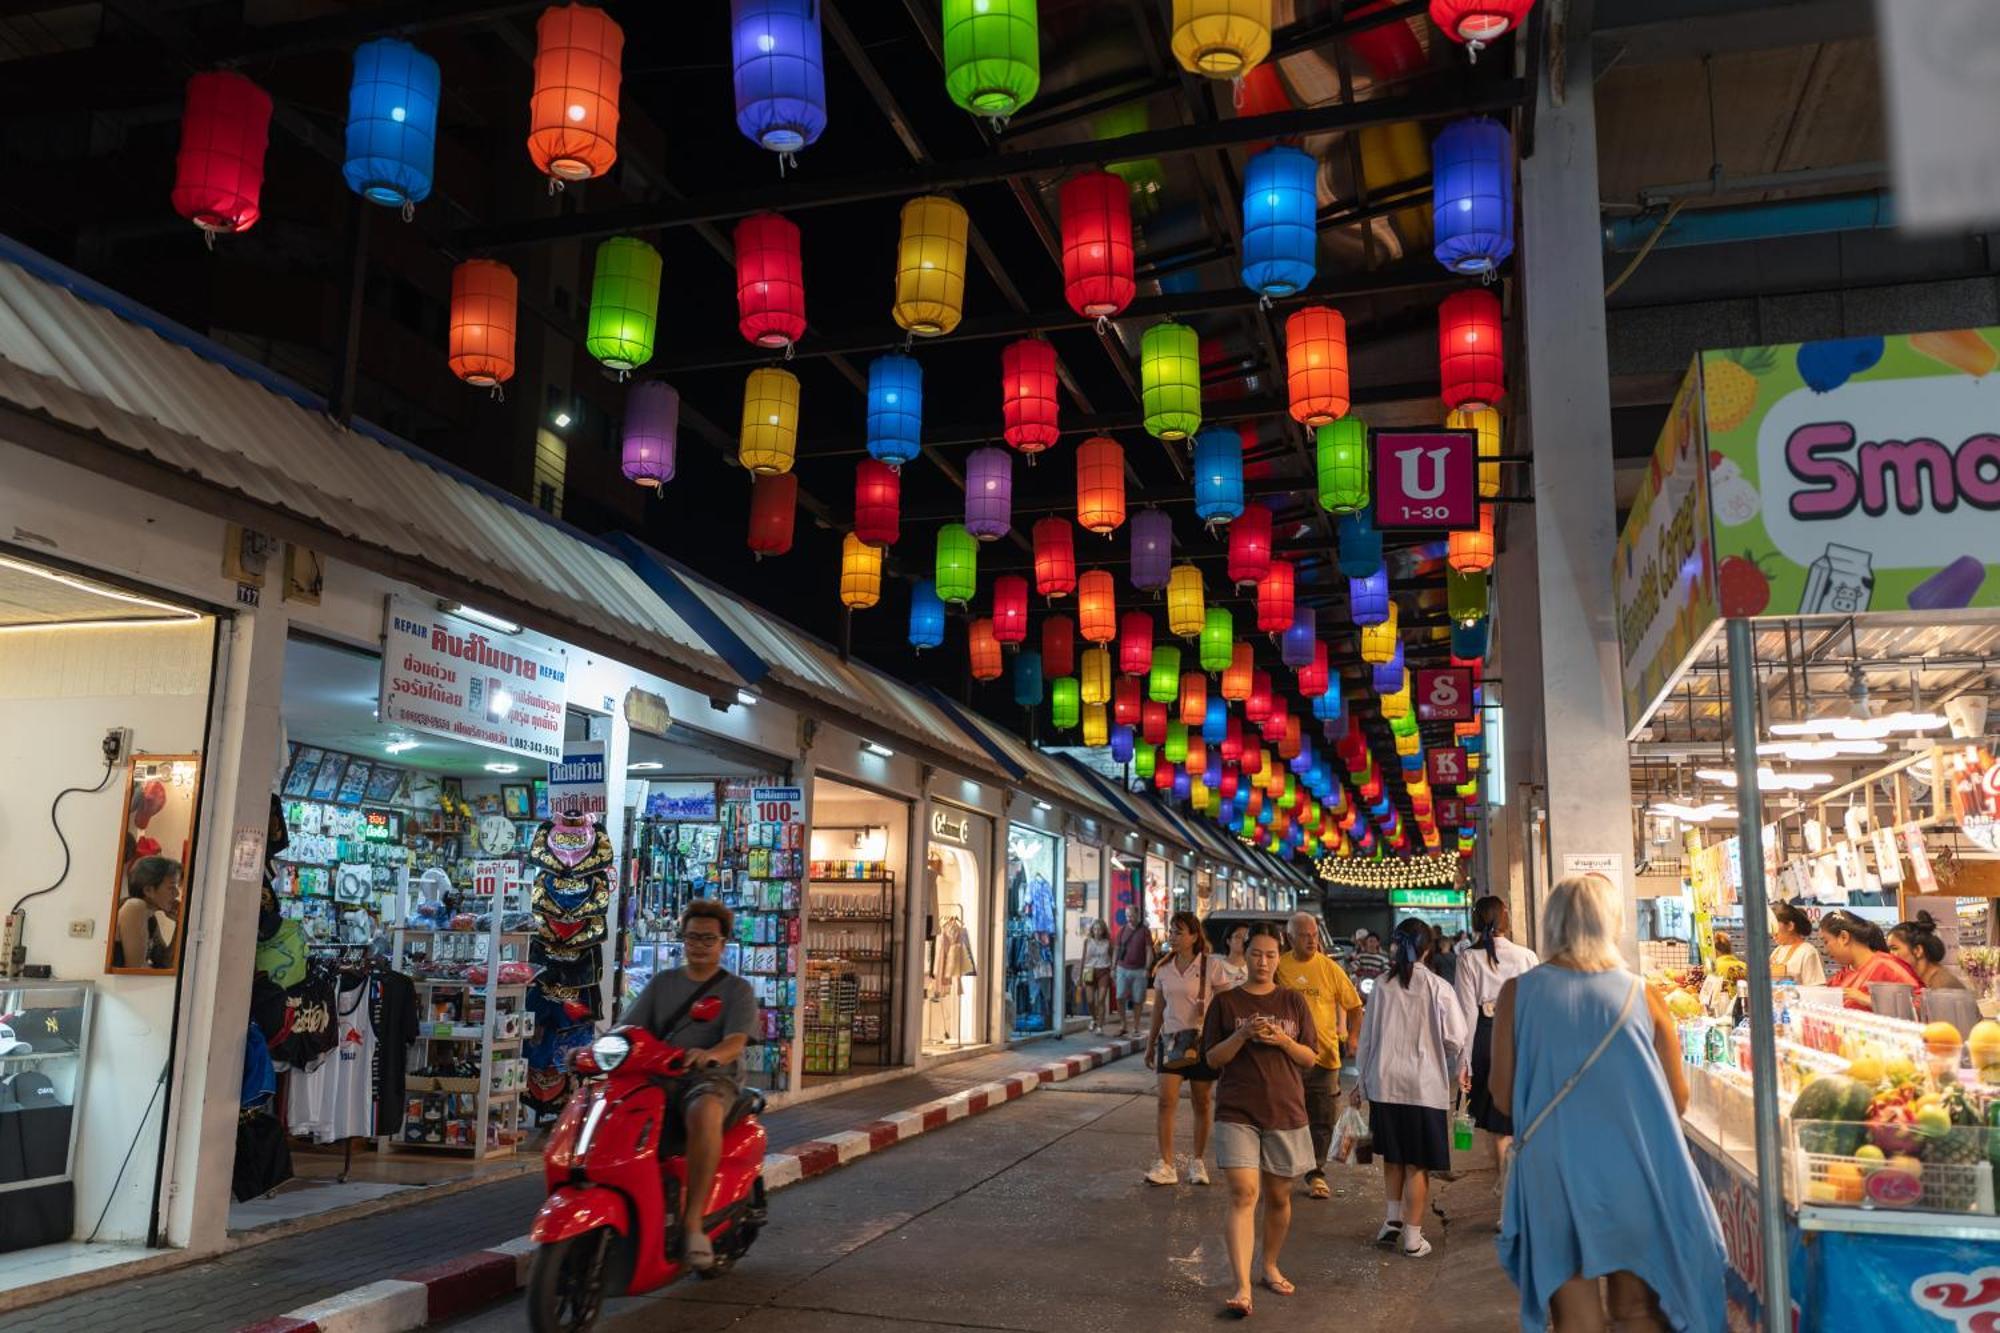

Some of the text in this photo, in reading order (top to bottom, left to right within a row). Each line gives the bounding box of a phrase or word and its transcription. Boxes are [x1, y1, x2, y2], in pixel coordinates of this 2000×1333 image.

[1395, 447, 1451, 499] U
[1401, 506, 1449, 519] 1-30
[394, 617, 427, 638] REPAIR
[403, 653, 456, 682] ซ่อมด่วน
[539, 665, 565, 683] REPAIR
[393, 678, 463, 707] รอรับได้เลย
[1430, 675, 1458, 705] S
[552, 758, 602, 781] ซอมด่วน
[1436, 753, 1459, 774] K
